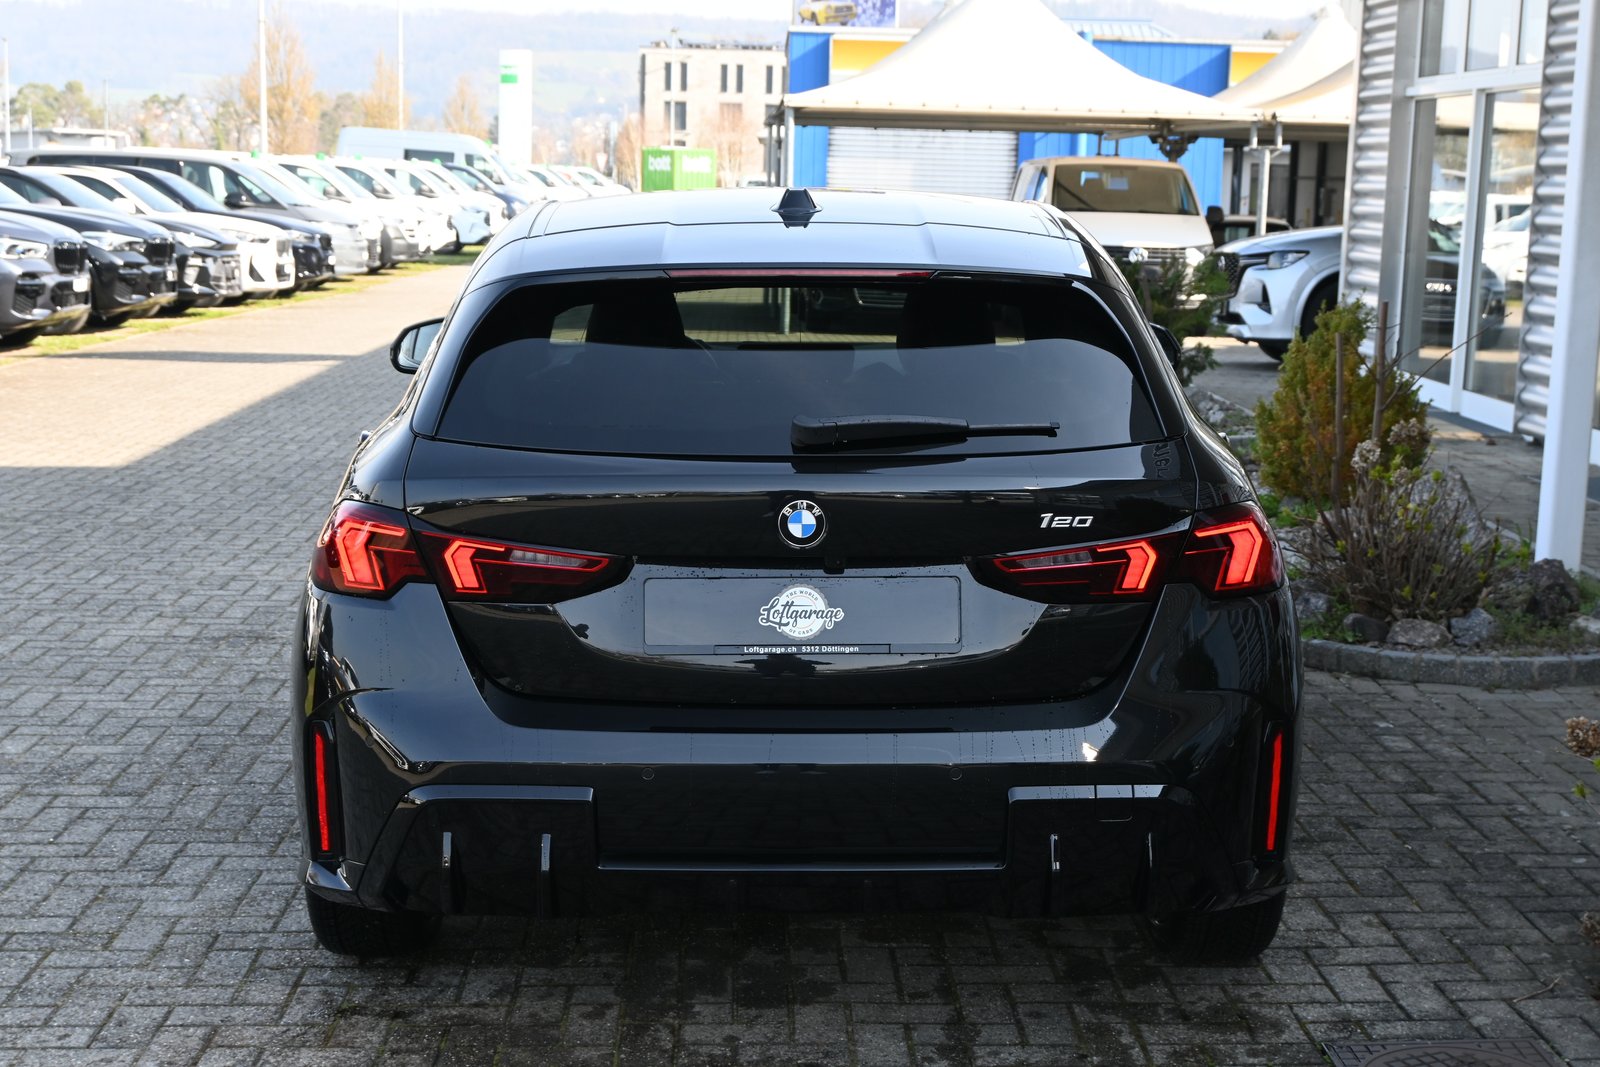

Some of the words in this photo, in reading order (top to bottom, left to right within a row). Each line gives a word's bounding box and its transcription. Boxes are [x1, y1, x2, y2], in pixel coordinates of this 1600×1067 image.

[783, 502, 822, 517] BMW
[1040, 513, 1094, 528] 120
[786, 590, 797, 599] THE
[799, 590, 819, 601] WORLD
[759, 597, 843, 631] Loftgarage
[744, 646, 797, 654] Loftgarage.ch
[822, 645, 859, 654] Döttingen
